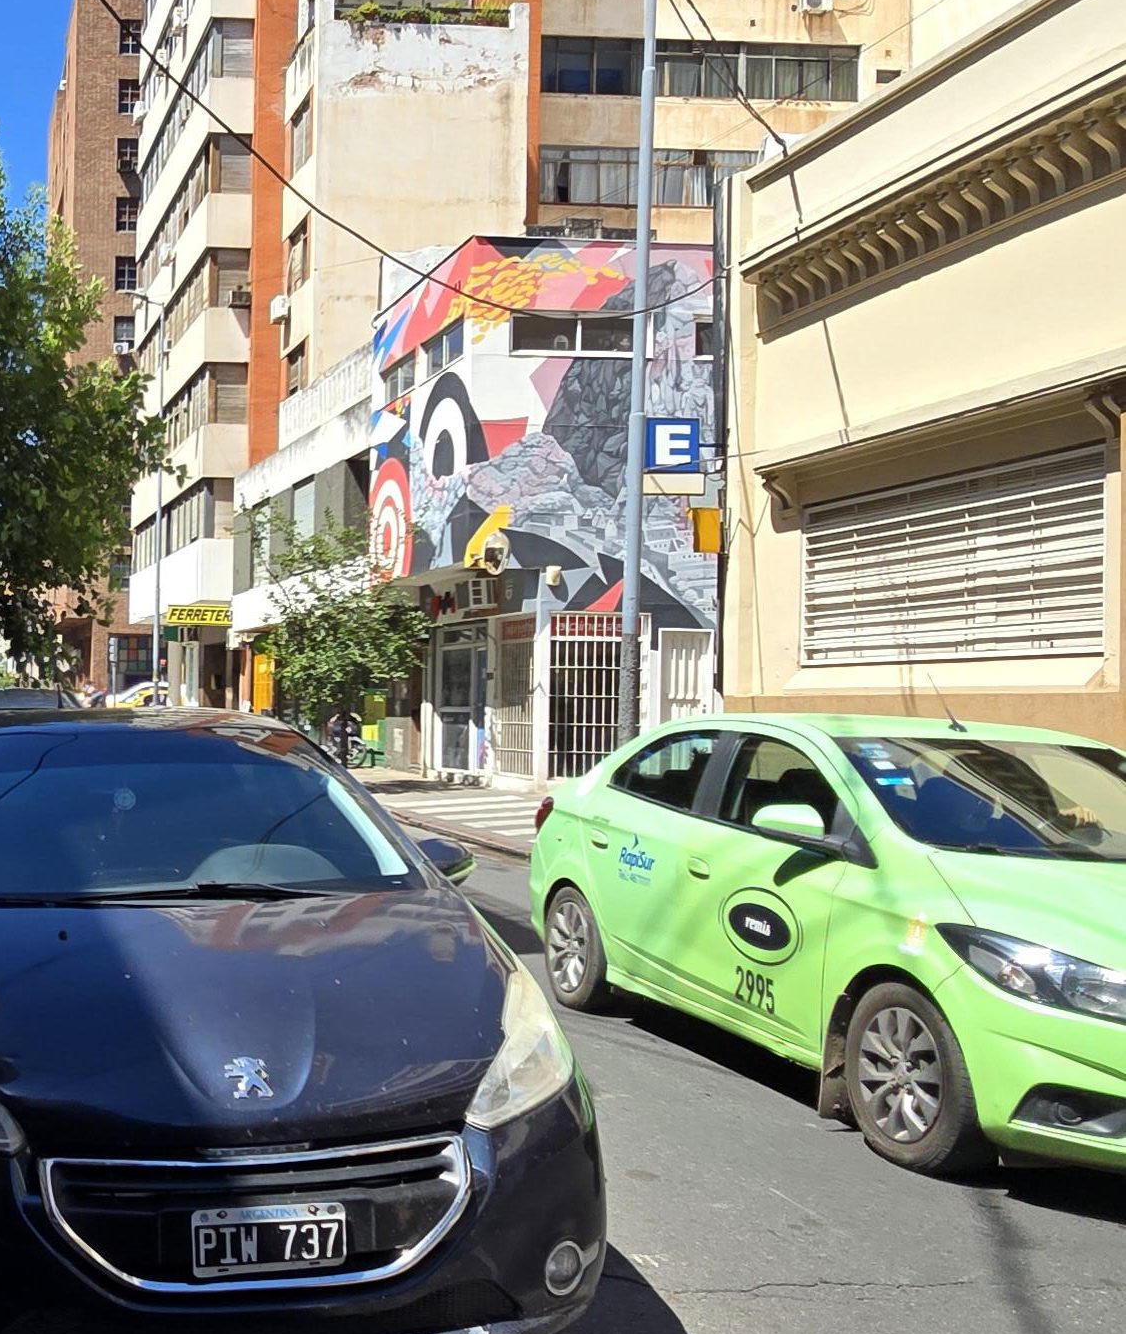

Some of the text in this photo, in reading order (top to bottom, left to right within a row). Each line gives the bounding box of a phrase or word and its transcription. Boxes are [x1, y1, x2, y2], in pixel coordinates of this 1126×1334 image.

[655, 426, 691, 465] E
[619, 847, 655, 871] RapiSur
[745, 917, 771, 936] remis
[735, 966, 774, 1014] 2995
[240, 1208, 299, 1220] ARGENTINA
[199, 1222, 339, 1266] PIW 737
